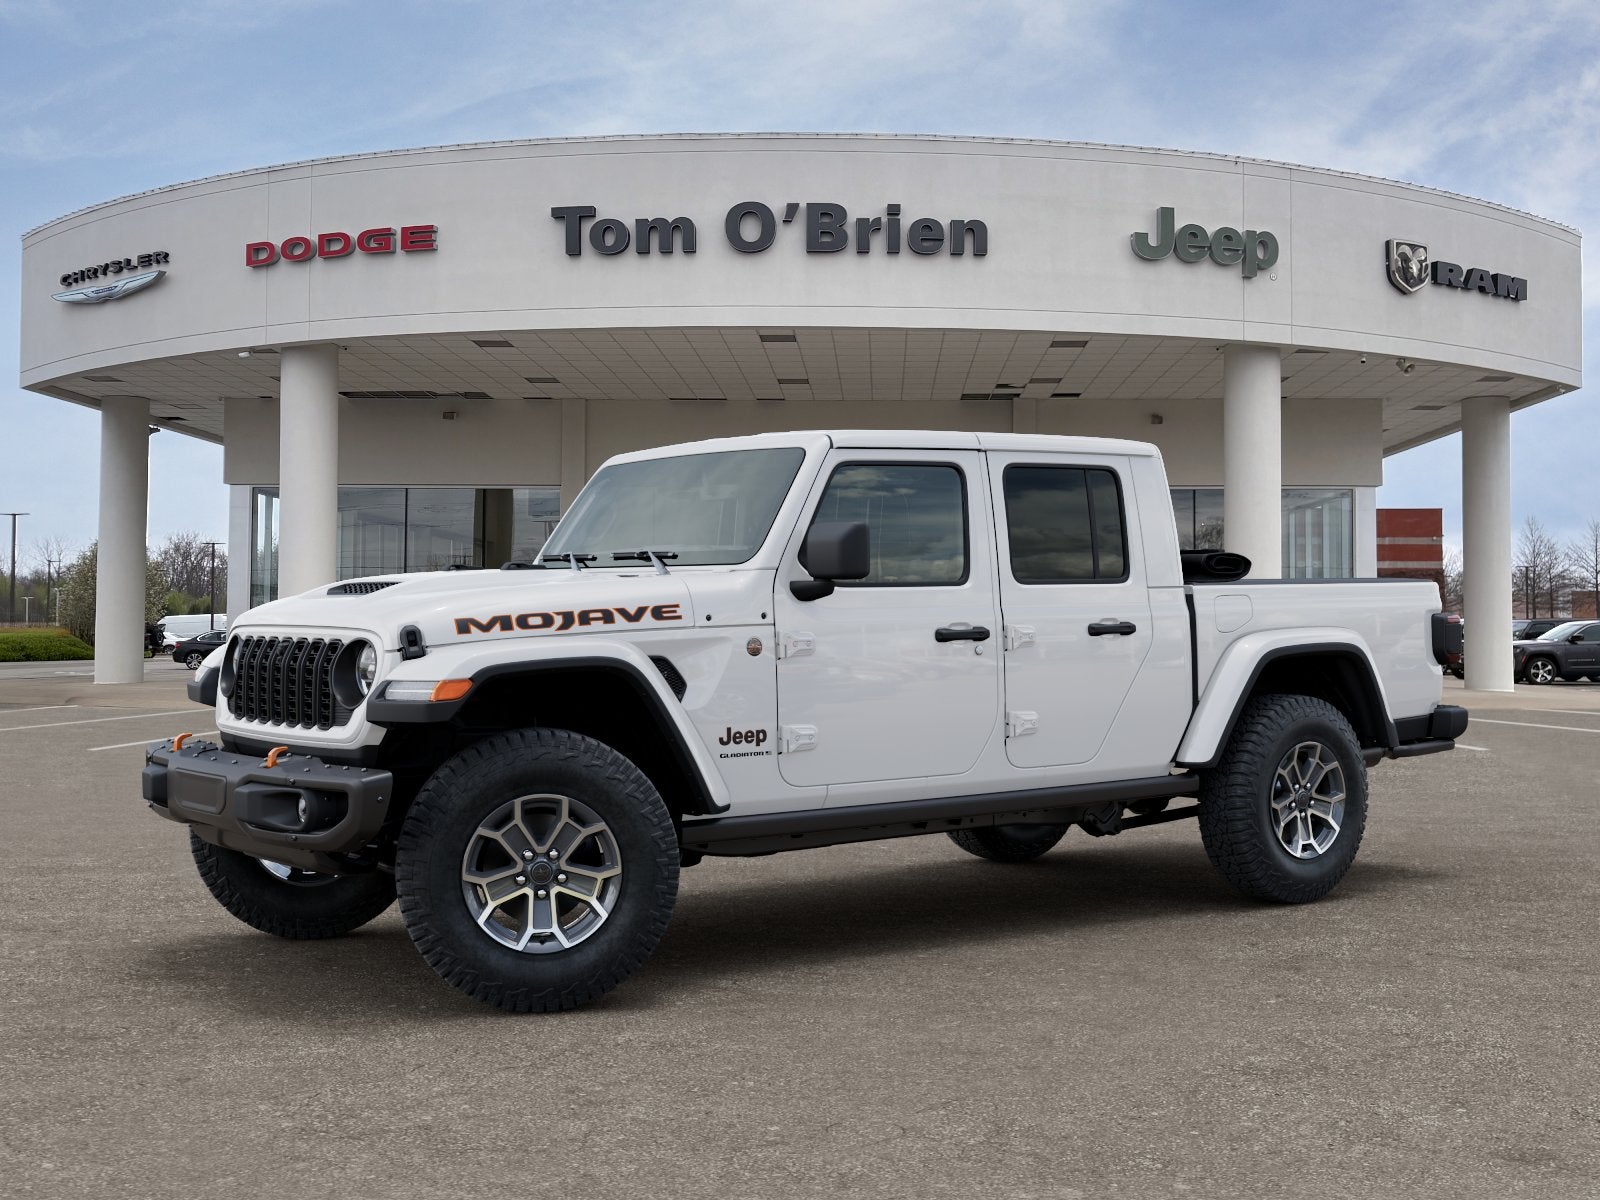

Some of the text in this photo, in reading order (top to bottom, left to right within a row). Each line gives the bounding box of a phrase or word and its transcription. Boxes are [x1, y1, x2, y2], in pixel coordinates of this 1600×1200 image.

[246, 225, 438, 267] DODGE
[551, 201, 989, 256] Tom O'Brien
[1130, 207, 1280, 279] Jeep
[60, 250, 170, 287] CHRYSLER
[1431, 261, 1528, 301] RAM
[454, 604, 682, 634] MOJAVE
[719, 727, 767, 746] Jeep
